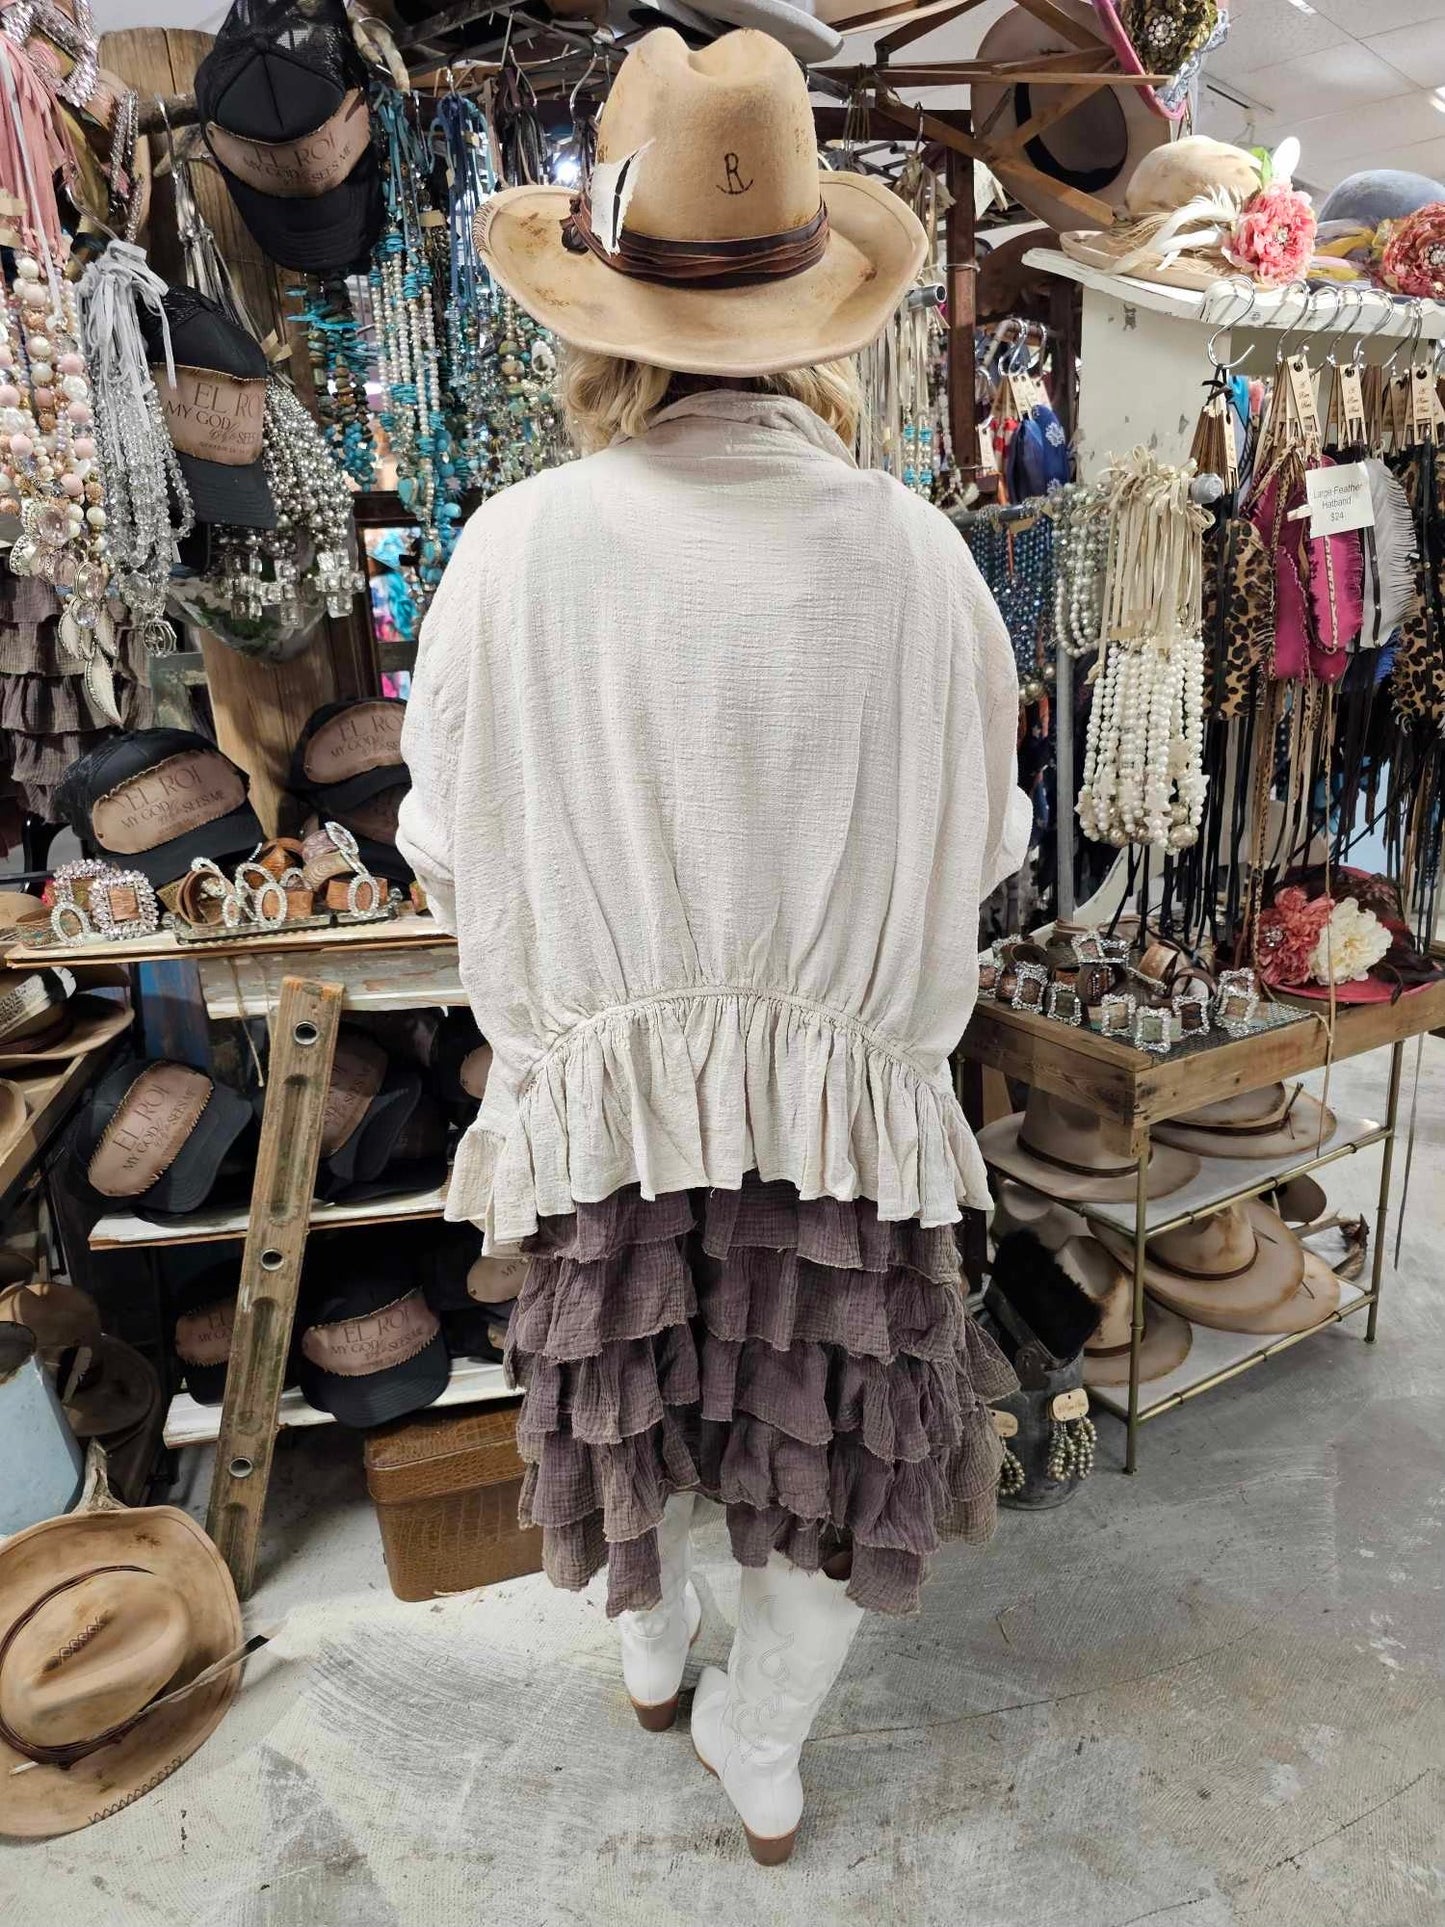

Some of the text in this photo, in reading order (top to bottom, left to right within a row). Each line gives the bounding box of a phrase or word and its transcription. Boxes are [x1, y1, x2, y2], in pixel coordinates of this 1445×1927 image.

[294, 132, 337, 167] ROI
[166, 400, 192, 419] MY
[196, 411, 231, 430] GOD
[194, 382, 260, 418] EL RO
[1313, 483, 1362, 499] Large Feather
[1322, 496, 1352, 509] Hatband
[371, 714, 404, 733] RO
[126, 764, 203, 812] EL ROI
[141, 801, 171, 821] GOD
[112, 1128, 141, 1152] EL
[134, 1083, 170, 1121] ROI
[137, 1125, 159, 1154] GOD
[344, 1305, 410, 1343] EL ROI
